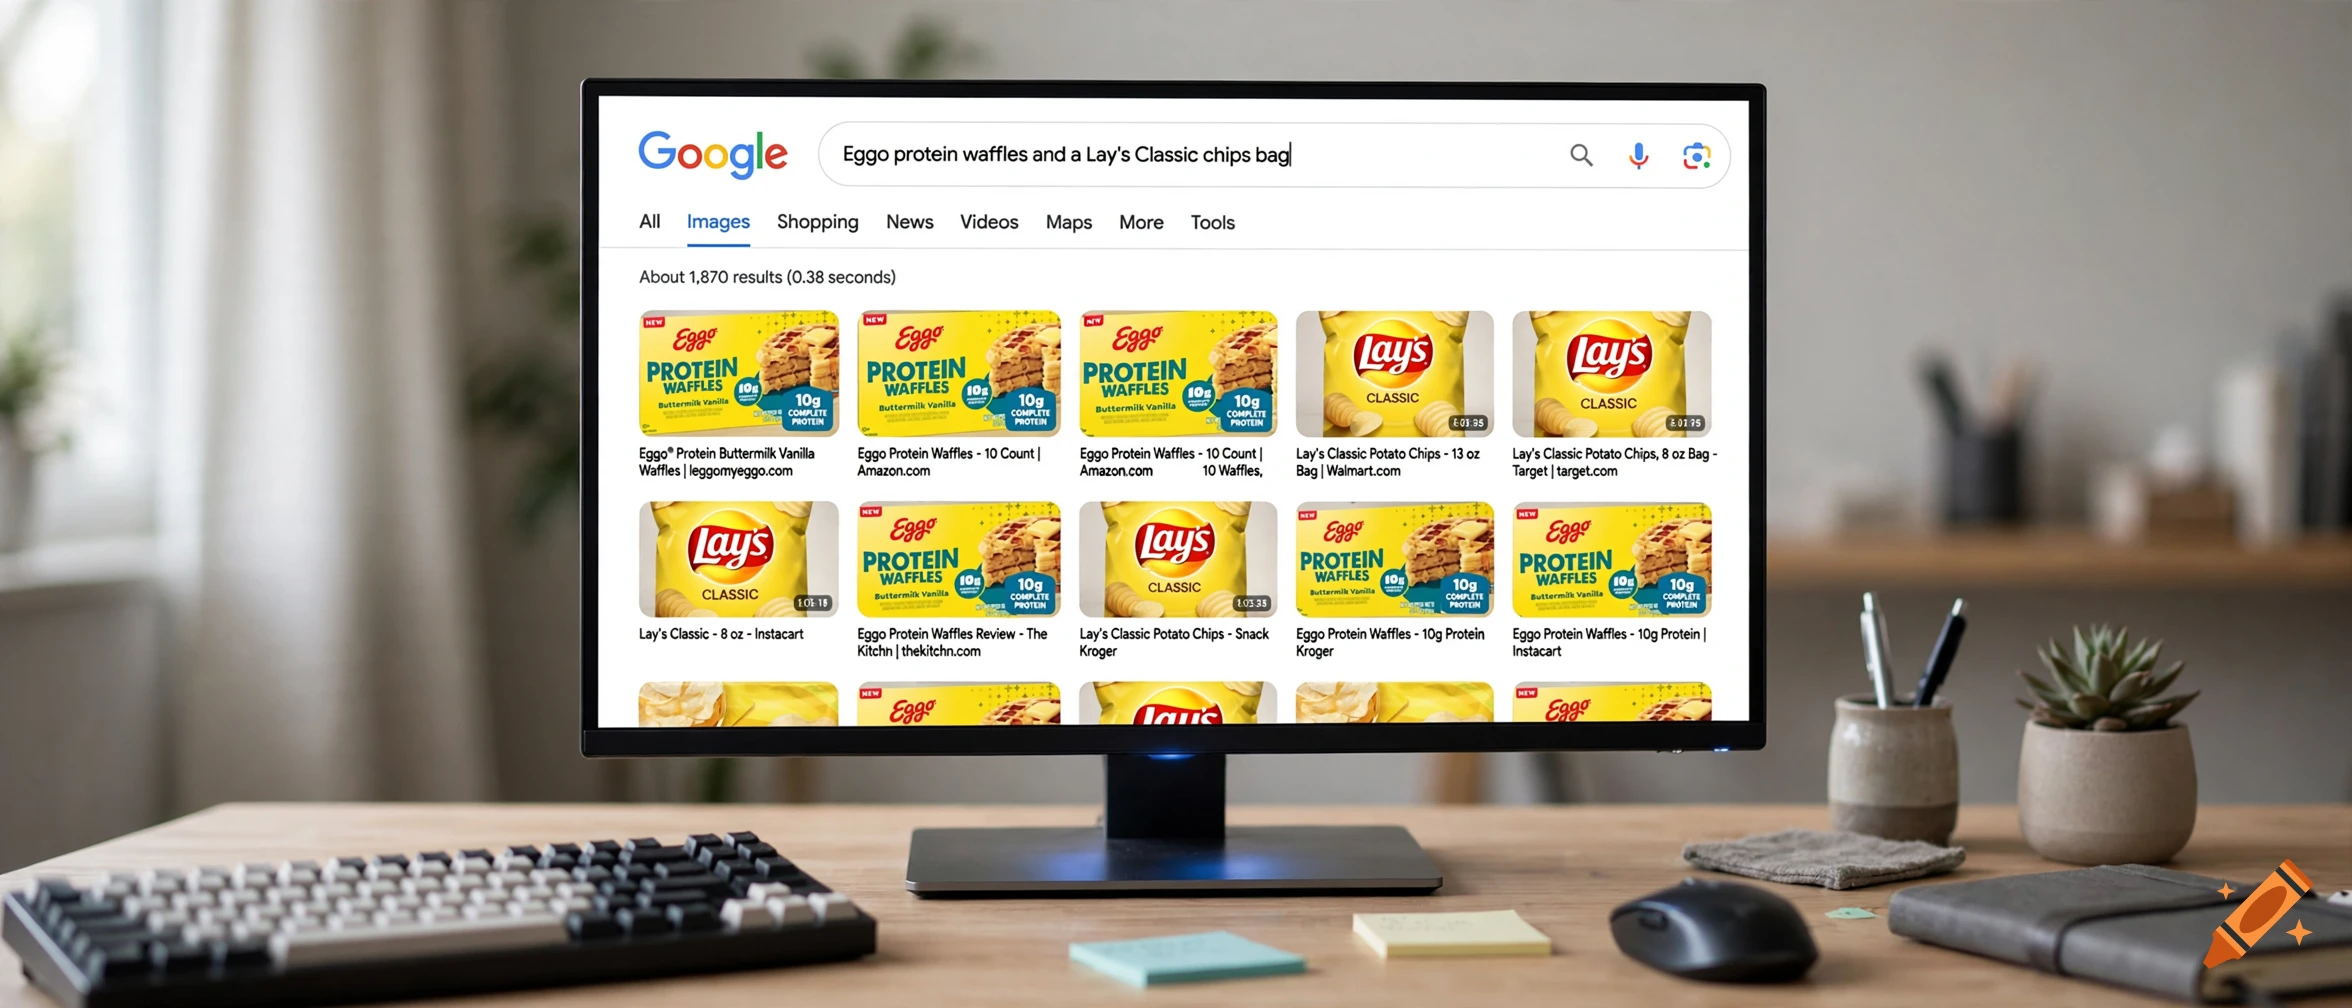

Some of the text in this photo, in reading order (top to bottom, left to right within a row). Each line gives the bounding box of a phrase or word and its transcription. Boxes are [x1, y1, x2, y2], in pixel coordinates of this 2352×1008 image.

[638, 131, 788, 180] Google
[844, 145, 1289, 167] Eggo protein waffles and a Lay's Classic chips bag
[640, 214, 1235, 233] All Images Shopping News Videos Maps More Tools
[640, 269, 895, 285] About 1,870 results (0.38 seconds)
[673, 328, 718, 352] Eggo
[895, 326, 944, 352] Eggo
[1112, 326, 1163, 352] Eggo
[1359, 336, 1428, 375] Lay's
[1572, 337, 1647, 379] Lay's
[647, 357, 738, 382] PROTEIN
[868, 357, 965, 383] PROTEIN
[1083, 358, 1187, 384] PROTEIN
[664, 380, 723, 394] WAFFLES
[885, 382, 949, 396] WAFFLES
[1102, 383, 1169, 397] WAFFLES
[659, 400, 700, 409] Buttermilk
[796, 394, 821, 408] 10g
[879, 401, 956, 412] Buttermilk Vanilla
[1019, 394, 1044, 408] 10g
[1235, 395, 1260, 409] 10g
[1367, 393, 1419, 403] CLASSIC
[1581, 399, 1637, 409] CLASSIC
[1096, 404, 1144, 413] Buttermilk
[676, 446, 717, 460] Protein
[719, 446, 777, 460] Buttermilk
[778, 446, 816, 460] Vanilla
[857, 446, 1035, 463] Eggo Protein Waffles 10 Count
[1080, 446, 1257, 463] Eggo Protein Waffles 10 Count
[1296, 446, 1481, 463] Lay's Classic Potato Chips 13 oz
[1512, 446, 1710, 463] Lay's Classic Potato Chips, 8 oz Bag
[638, 463, 794, 480] Waffles leggomyeggo.com
[856, 464, 931, 477] Amazon.com
[1079, 463, 1154, 477] Amazon.com
[1202, 463, 1263, 479] 10 Waffles,
[1296, 463, 1402, 480] Bag Walmart.com
[1511, 464, 1618, 481] Target target.com
[890, 518, 937, 542] Eggo
[1324, 521, 1364, 543] Eggo
[1546, 520, 1591, 544] Eggo
[693, 528, 768, 570] Lay's
[1140, 525, 1210, 564] Lay's
[864, 548, 958, 572] PROTEIN
[1301, 548, 1383, 571] PROTEIN
[1520, 550, 1612, 573] PROTEIN
[880, 571, 942, 585] WAFFLES
[1315, 570, 1369, 582] WAFFLES
[1537, 572, 1597, 586] WAFFLES
[1018, 578, 1043, 592] 10g
[1149, 583, 1201, 593] CLASSIC
[1453, 579, 1477, 592] 10g
[1670, 579, 1694, 592] 10g
[702, 589, 758, 600] CLASSIC
[922, 590, 949, 598] Vanilla
[639, 627, 805, 643] Lay's Classic 8 oz Instacart
[857, 627, 1048, 644] Eggo Protein Waffles Review The
[1079, 627, 1270, 643] Lay's Classic Potato Chips Snack
[1296, 626, 1485, 644] Eggo Protein Waffles 10g Protein
[1512, 627, 1701, 644] Eggo Protein Waffles 10g Protein
[857, 643, 982, 658] Kitchn thekitchn.com
[1079, 644, 1118, 661] Kroger
[1296, 644, 1335, 660] Kroger
[1512, 644, 1562, 658] Instacart
[890, 700, 936, 724] Eggo
[1546, 699, 1591, 721] Eggo
